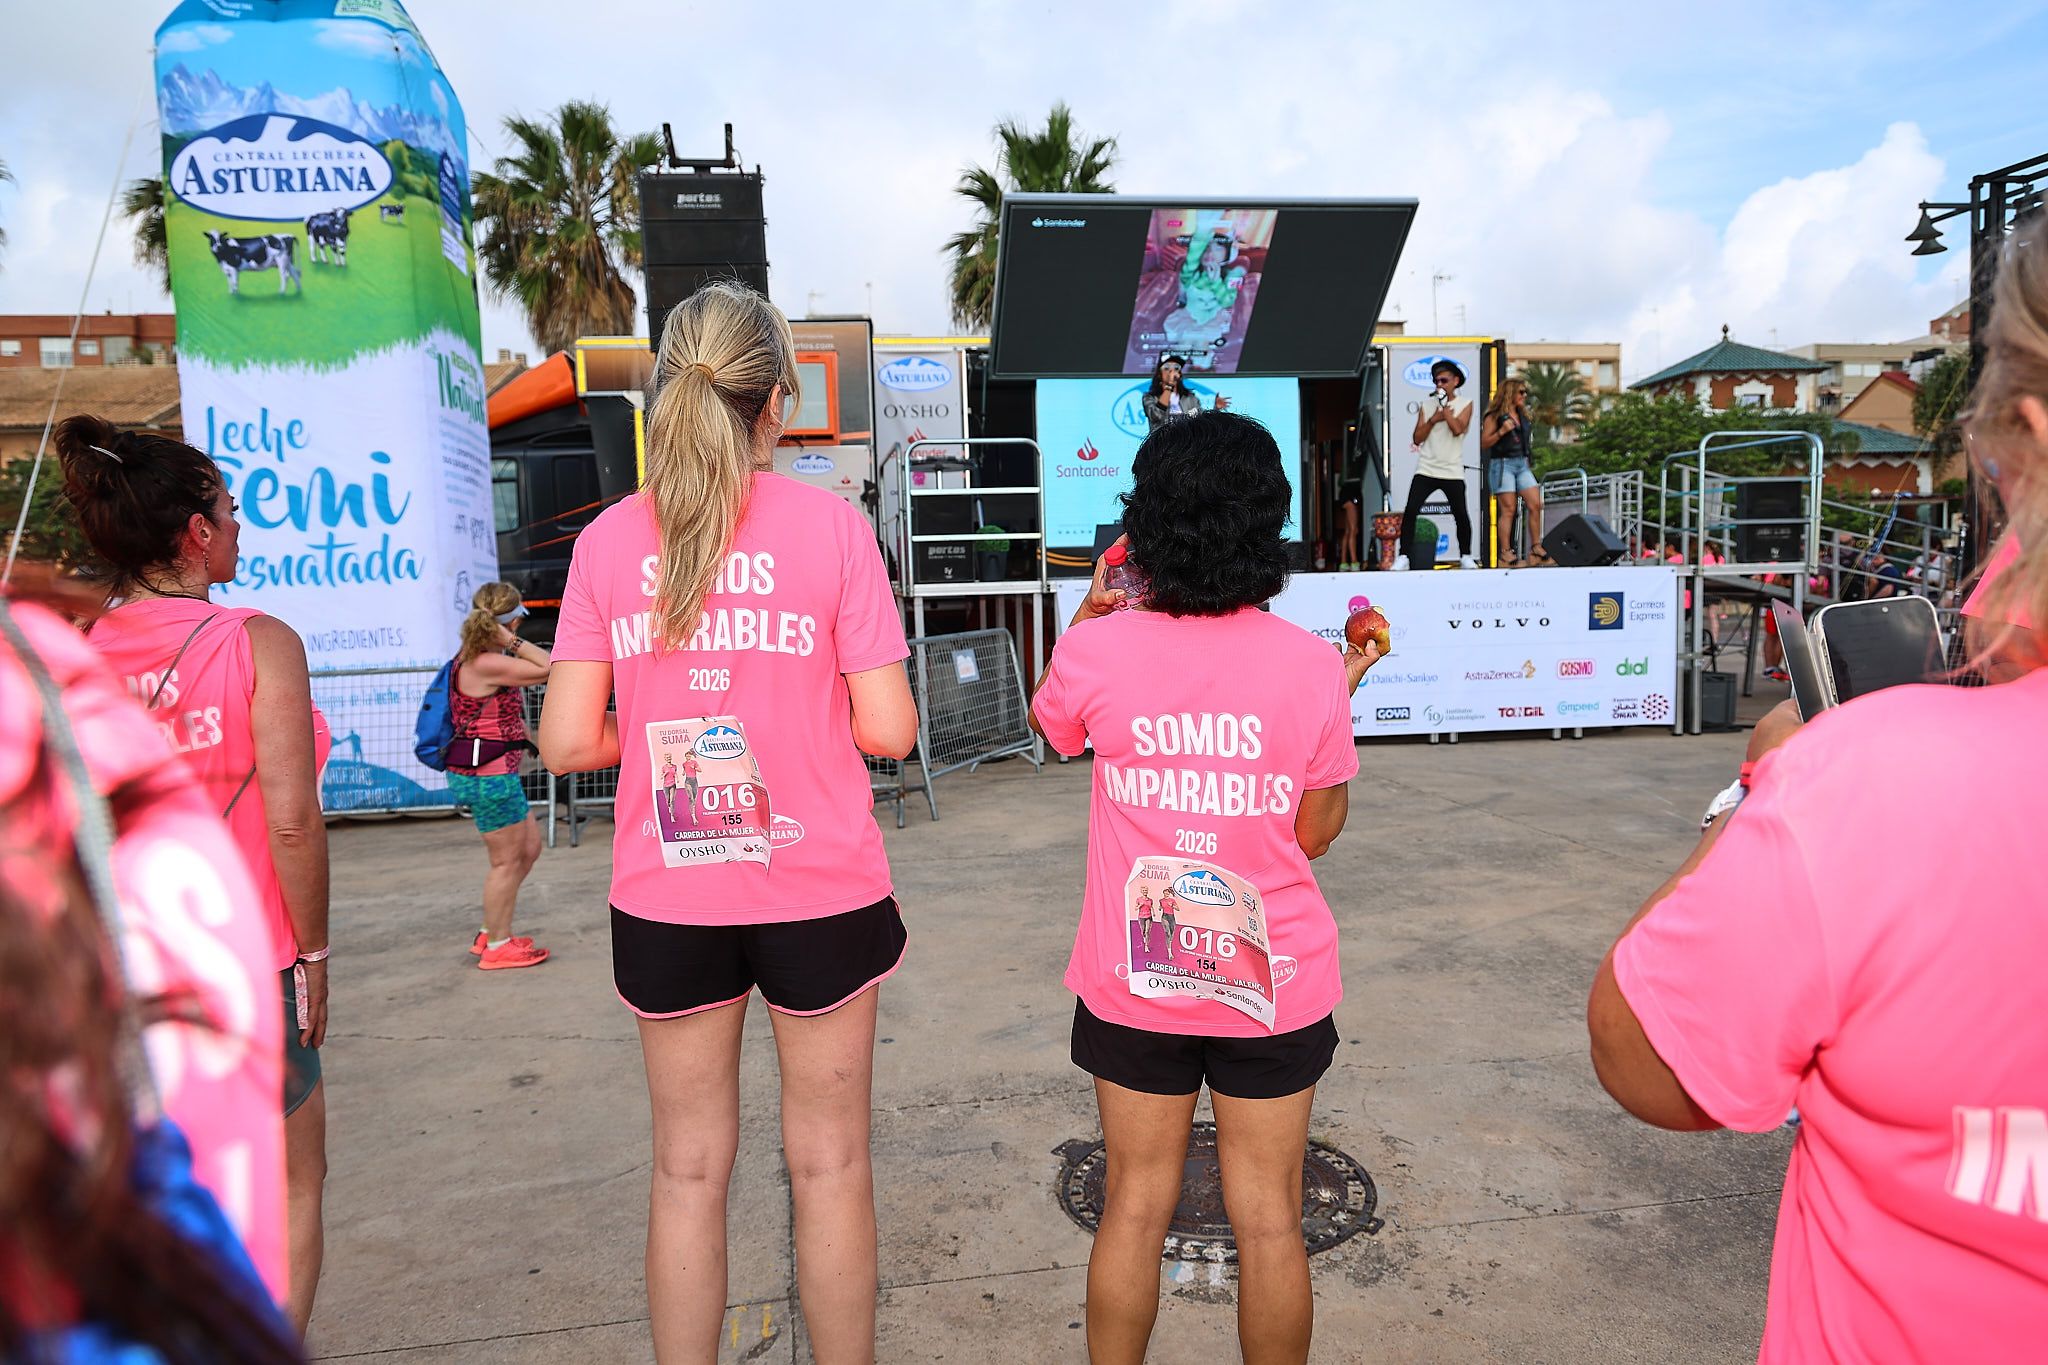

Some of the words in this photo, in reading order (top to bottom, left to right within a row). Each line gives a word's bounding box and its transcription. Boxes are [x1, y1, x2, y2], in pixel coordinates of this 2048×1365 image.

[213, 152, 284, 162] CENTRAL
[293, 151, 366, 161] LECHERA
[181, 155, 376, 196] ASTURIANA
[1043, 218, 1086, 228] Santander
[885, 370, 946, 382] ASTURIANA
[884, 403, 949, 419] OYSHO
[207, 406, 309, 462] Leche
[1056, 464, 1120, 478] Santander
[209, 531, 425, 595] esnatada
[640, 551, 775, 596] SOS
[1507, 600, 1546, 609] OFICIAL
[1631, 600, 1665, 609] Correos
[1447, 617, 1550, 629] VOLVO
[1631, 611, 1665, 621] Express
[307, 627, 409, 652] INGREDIENTES:
[1560, 661, 1593, 676] COSMO
[1616, 656, 1648, 676] dial
[688, 668, 731, 691] 2026
[1465, 670, 1524, 680] AstraZeneca
[661, 734, 691, 745] SUMA
[1131, 712, 1262, 760] SOMOS
[700, 739, 743, 752] ASTURIANA
[1104, 761, 1294, 817] IMPARABLES
[702, 783, 757, 811] 016
[721, 814, 742, 825] 155
[674, 831, 706, 840] CARRERA
[707, 830, 717, 838] DE
[718, 829, 728, 837] LA
[729, 826, 755, 836] MUJER
[1175, 828, 1218, 855] 2026
[679, 844, 726, 859] OYSHO
[1139, 869, 1171, 881] SUMA
[1179, 879, 1233, 903] ASTURIANA
[1179, 926, 1237, 958] 016
[1145, 961, 1178, 975] CARRERA
[1179, 968, 1189, 976] DE
[1190, 970, 1200, 979] LA
[1201, 972, 1227, 983] MUJER
[1196, 958, 1216, 971] 154
[1148, 977, 1196, 990] OYSHO
[1226, 990, 1263, 1014] Santander
